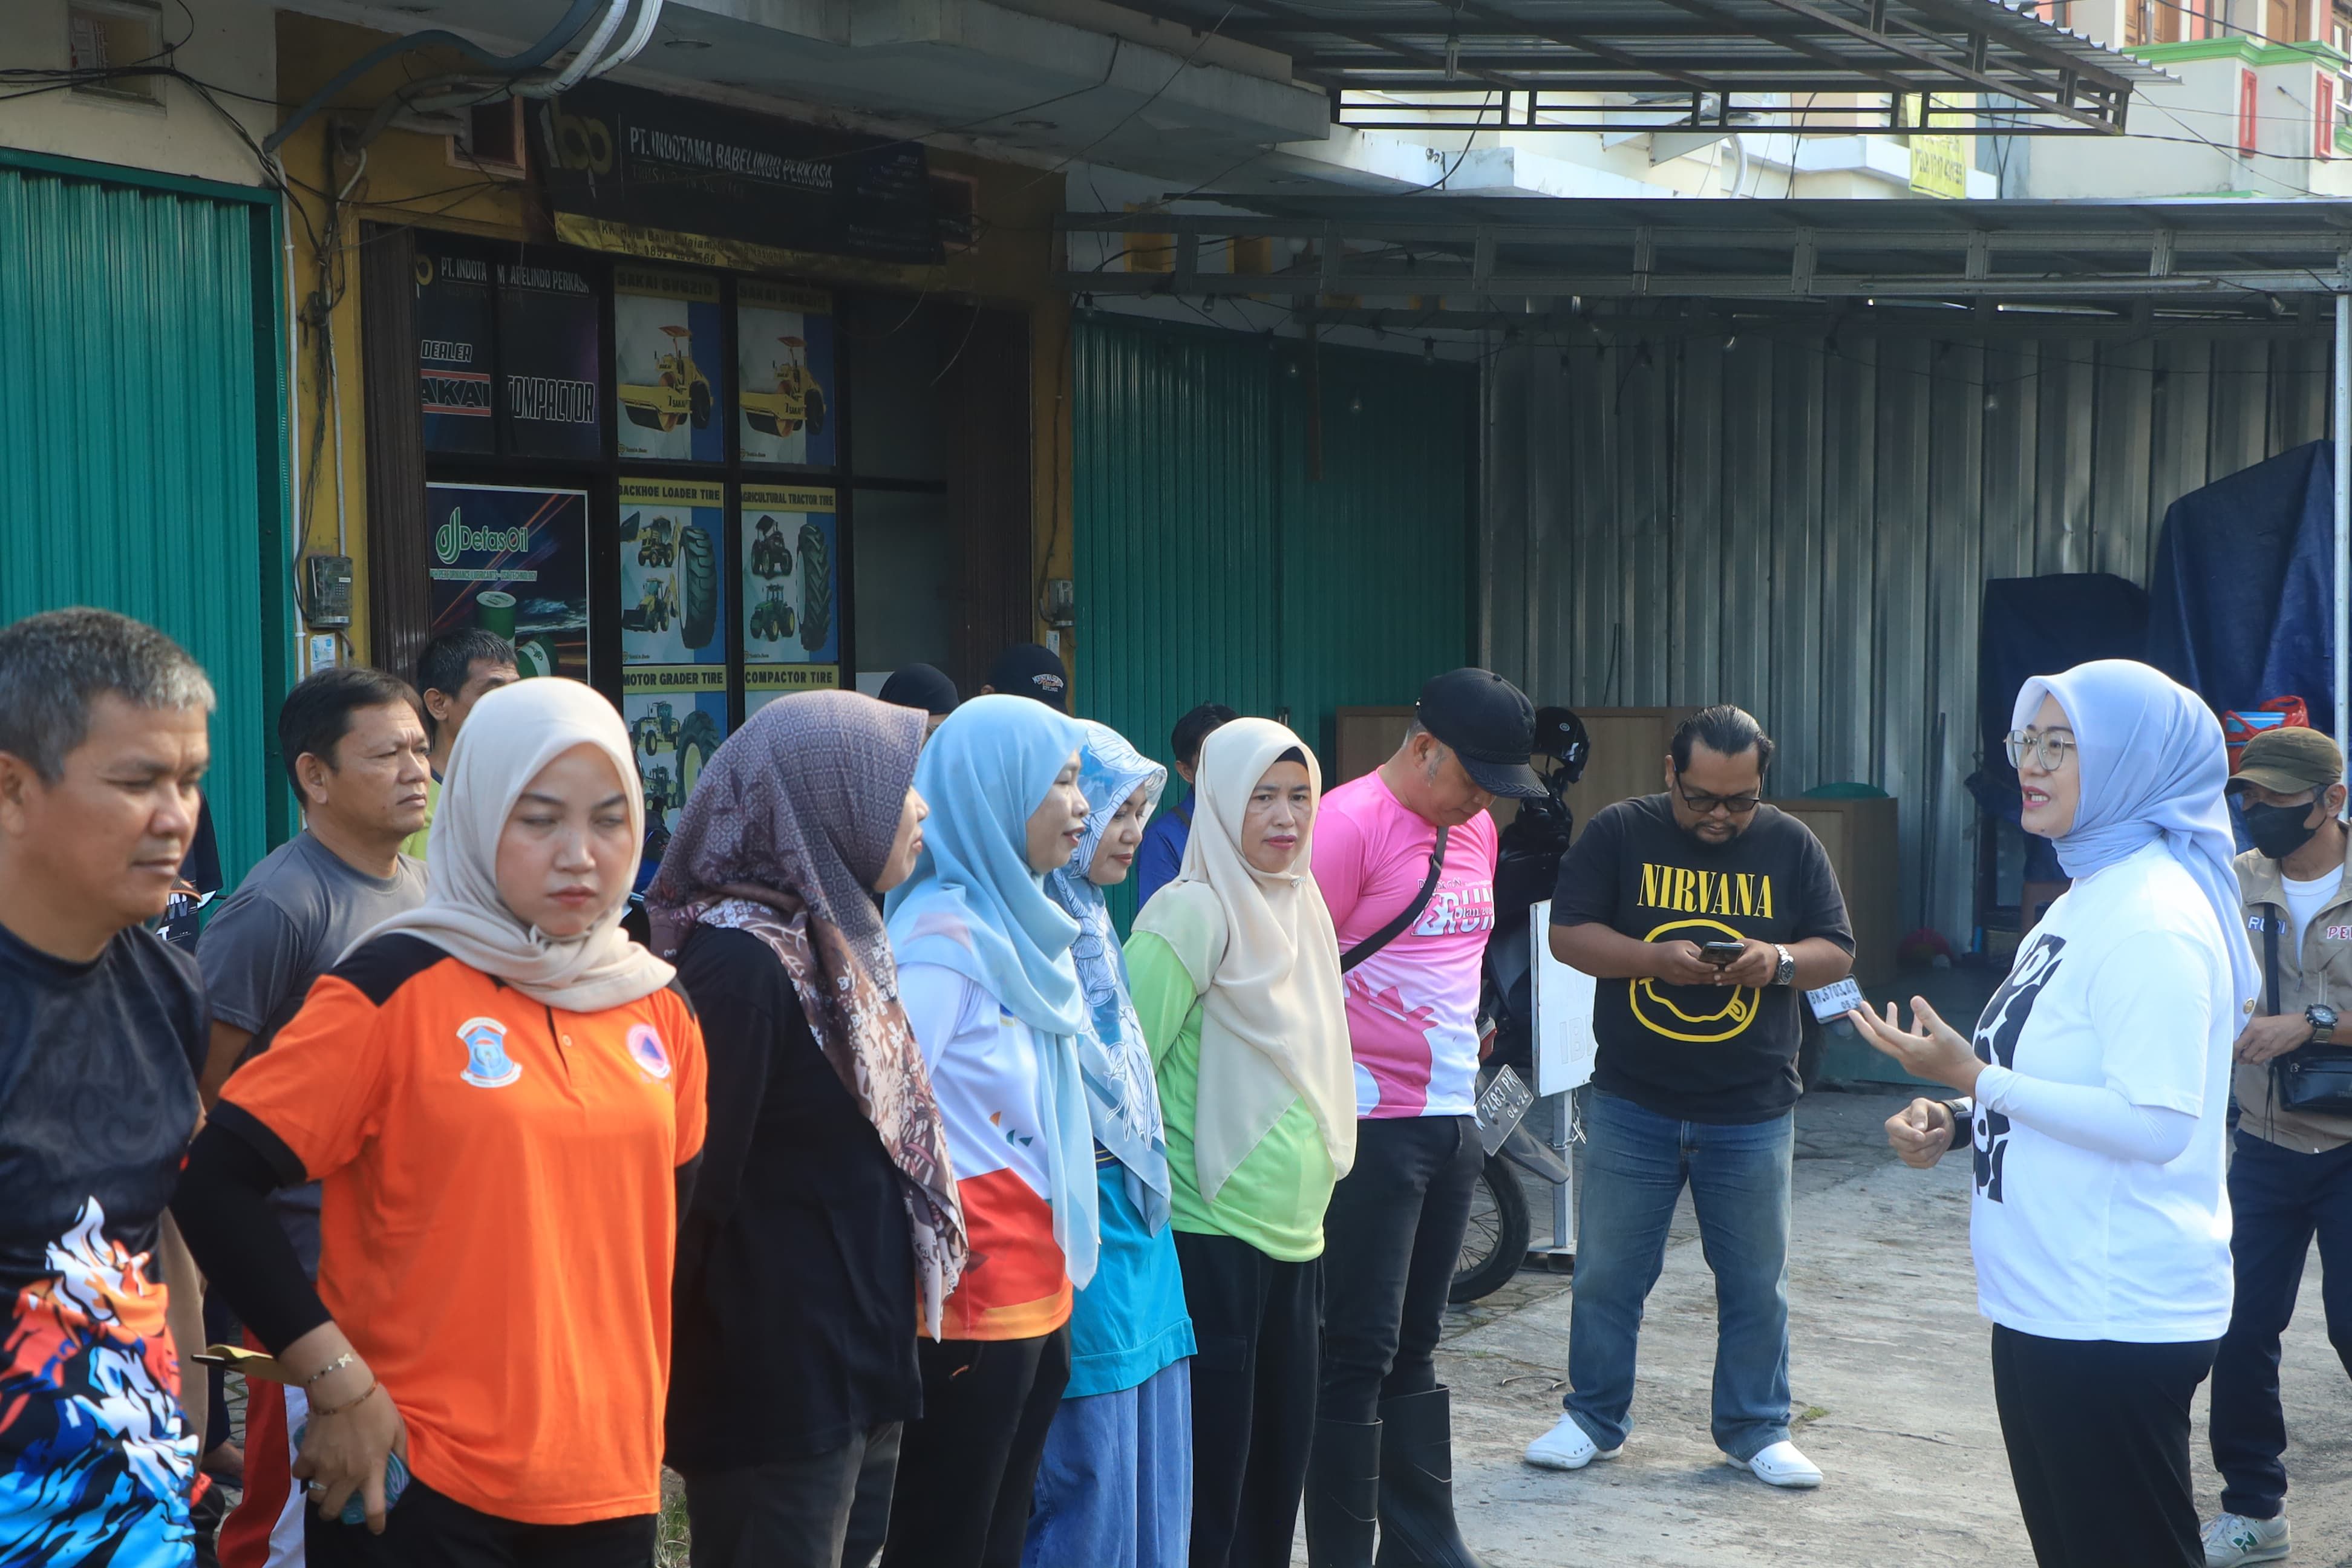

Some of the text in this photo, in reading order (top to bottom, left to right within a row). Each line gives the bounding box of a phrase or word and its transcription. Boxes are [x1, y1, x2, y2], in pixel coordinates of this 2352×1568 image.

[630, 126, 650, 155] PT.
[652, 130, 714, 168] INDOTAMA
[716, 143, 782, 180] BABELINDO
[782, 158, 833, 189] PERKASA
[440, 257, 454, 278] PT.
[421, 339, 473, 363] DEALER
[421, 377, 492, 408] AKAI
[618, 485, 720, 501] BACKHOE LOADER TIRE
[788, 494, 817, 506] TRACTOR
[818, 495, 834, 506] TIRE
[622, 671, 724, 687] MOTOR GRADER TIRE
[745, 671, 833, 685] COMPACTOR TIRE
[1636, 863, 1774, 919] NIRVANA
[1481, 1086, 1506, 1119] 2483
[1501, 1070, 1518, 1093] PK
